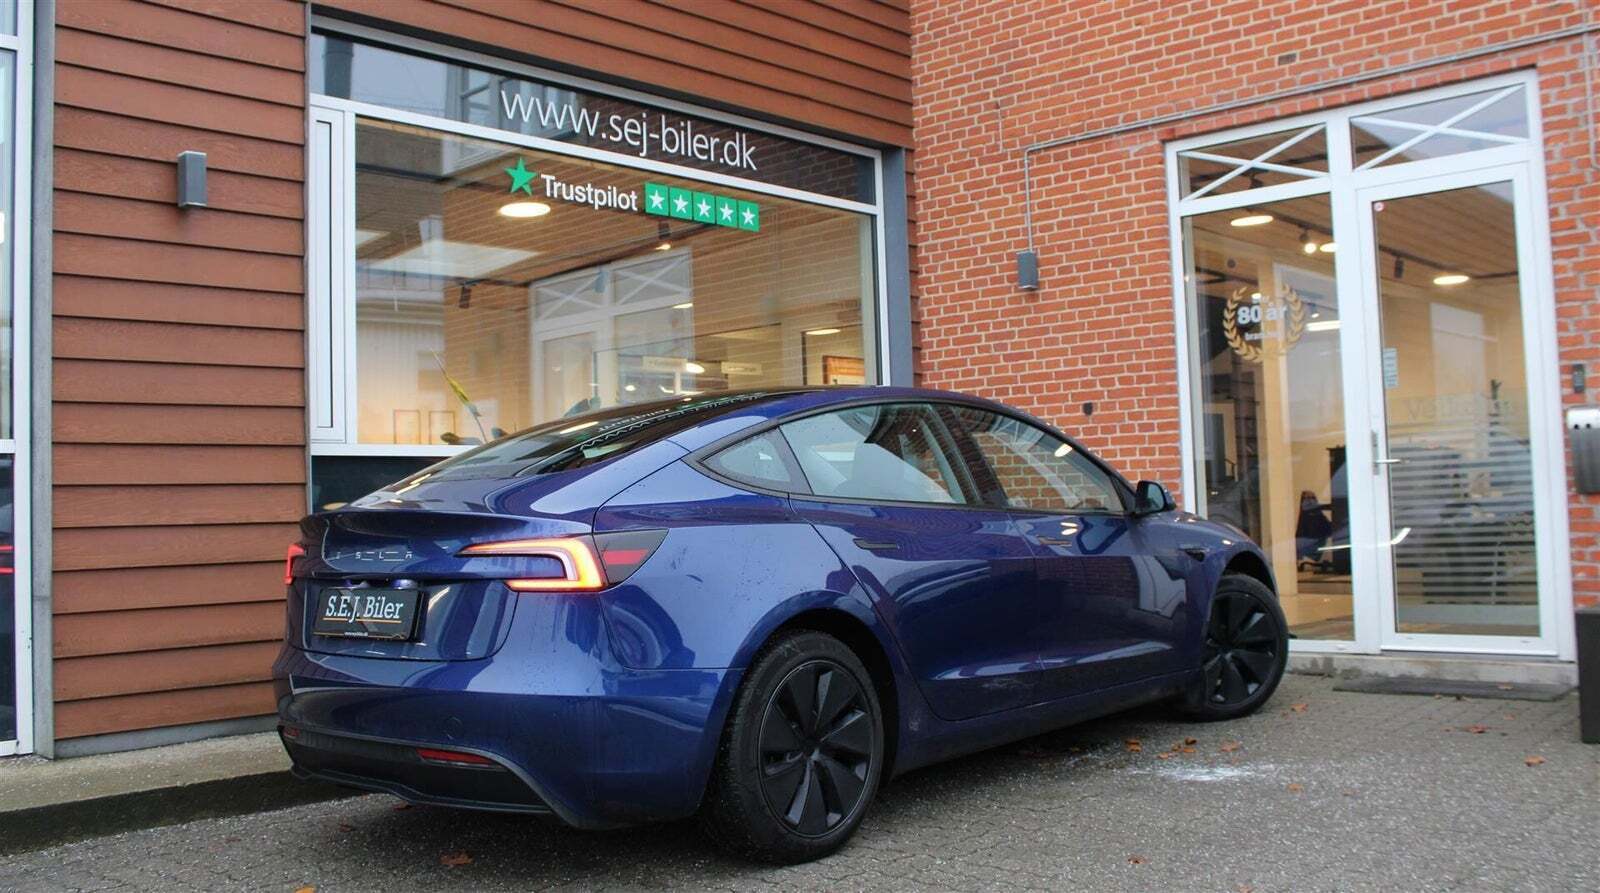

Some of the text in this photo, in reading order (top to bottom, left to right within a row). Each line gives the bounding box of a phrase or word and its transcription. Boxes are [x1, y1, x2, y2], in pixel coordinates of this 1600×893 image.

[500, 89, 758, 171] www.sej-biler.dk
[540, 173, 638, 211] Trustpilot
[1237, 301, 1288, 325] 80 år
[325, 595, 404, 623] S.E.J. Biler
